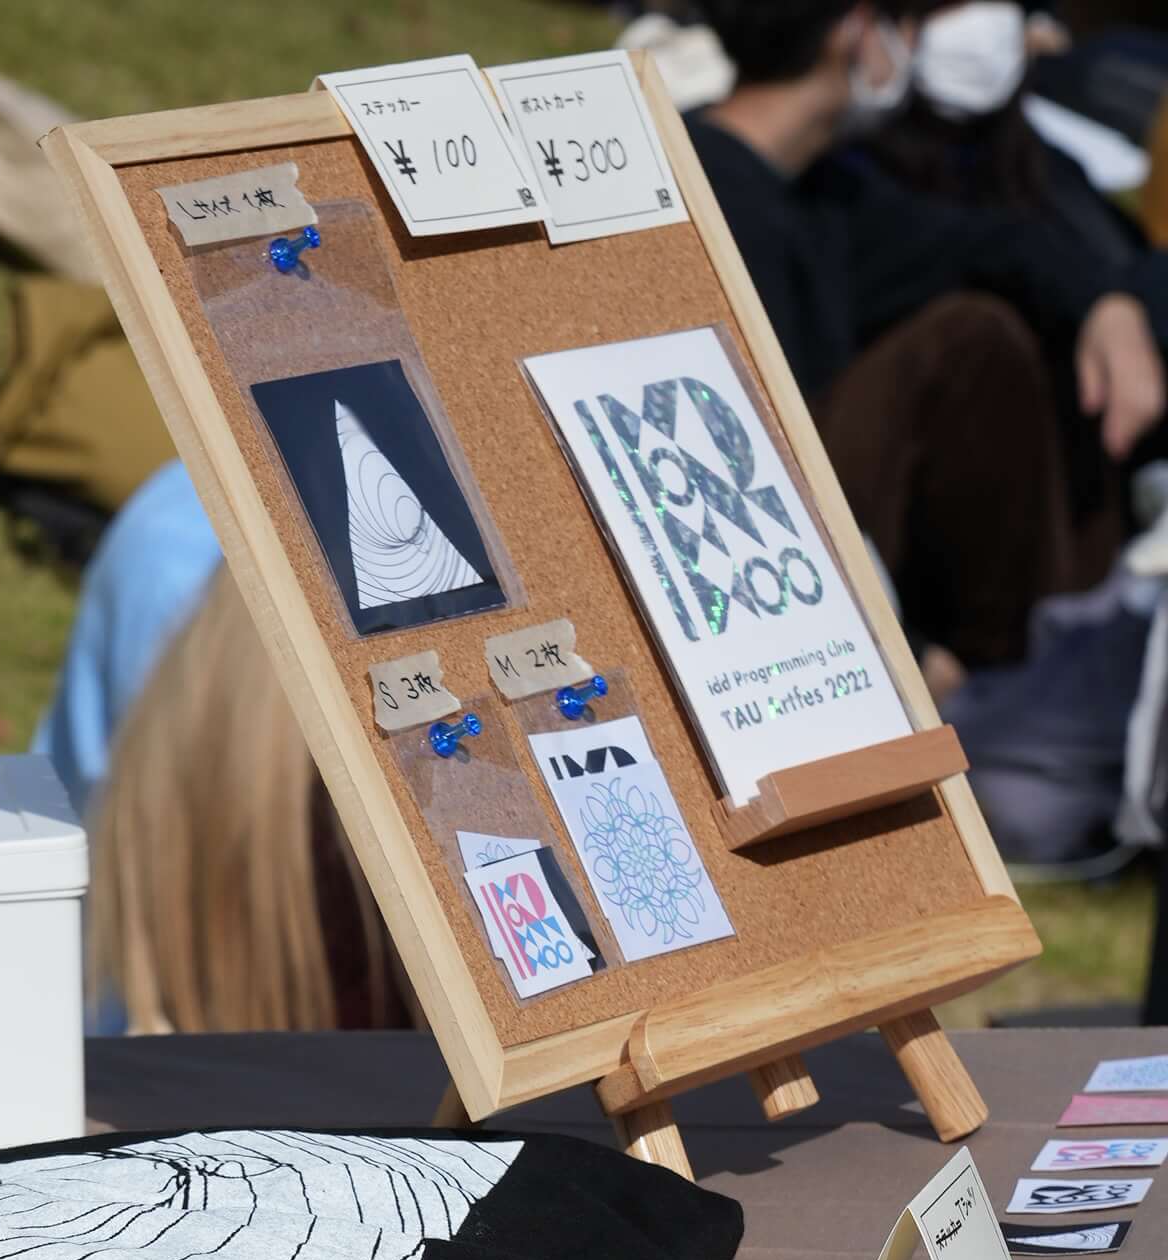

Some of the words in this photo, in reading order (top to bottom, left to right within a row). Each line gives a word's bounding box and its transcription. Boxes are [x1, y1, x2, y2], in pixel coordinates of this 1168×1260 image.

[361, 98, 421, 116] ステッカー
[494, 655, 521, 678] M
[378, 681, 399, 710] S
[720, 700, 763, 732] TAU
[767, 685, 824, 720] Artfes
[825, 666, 873, 699] 2022
